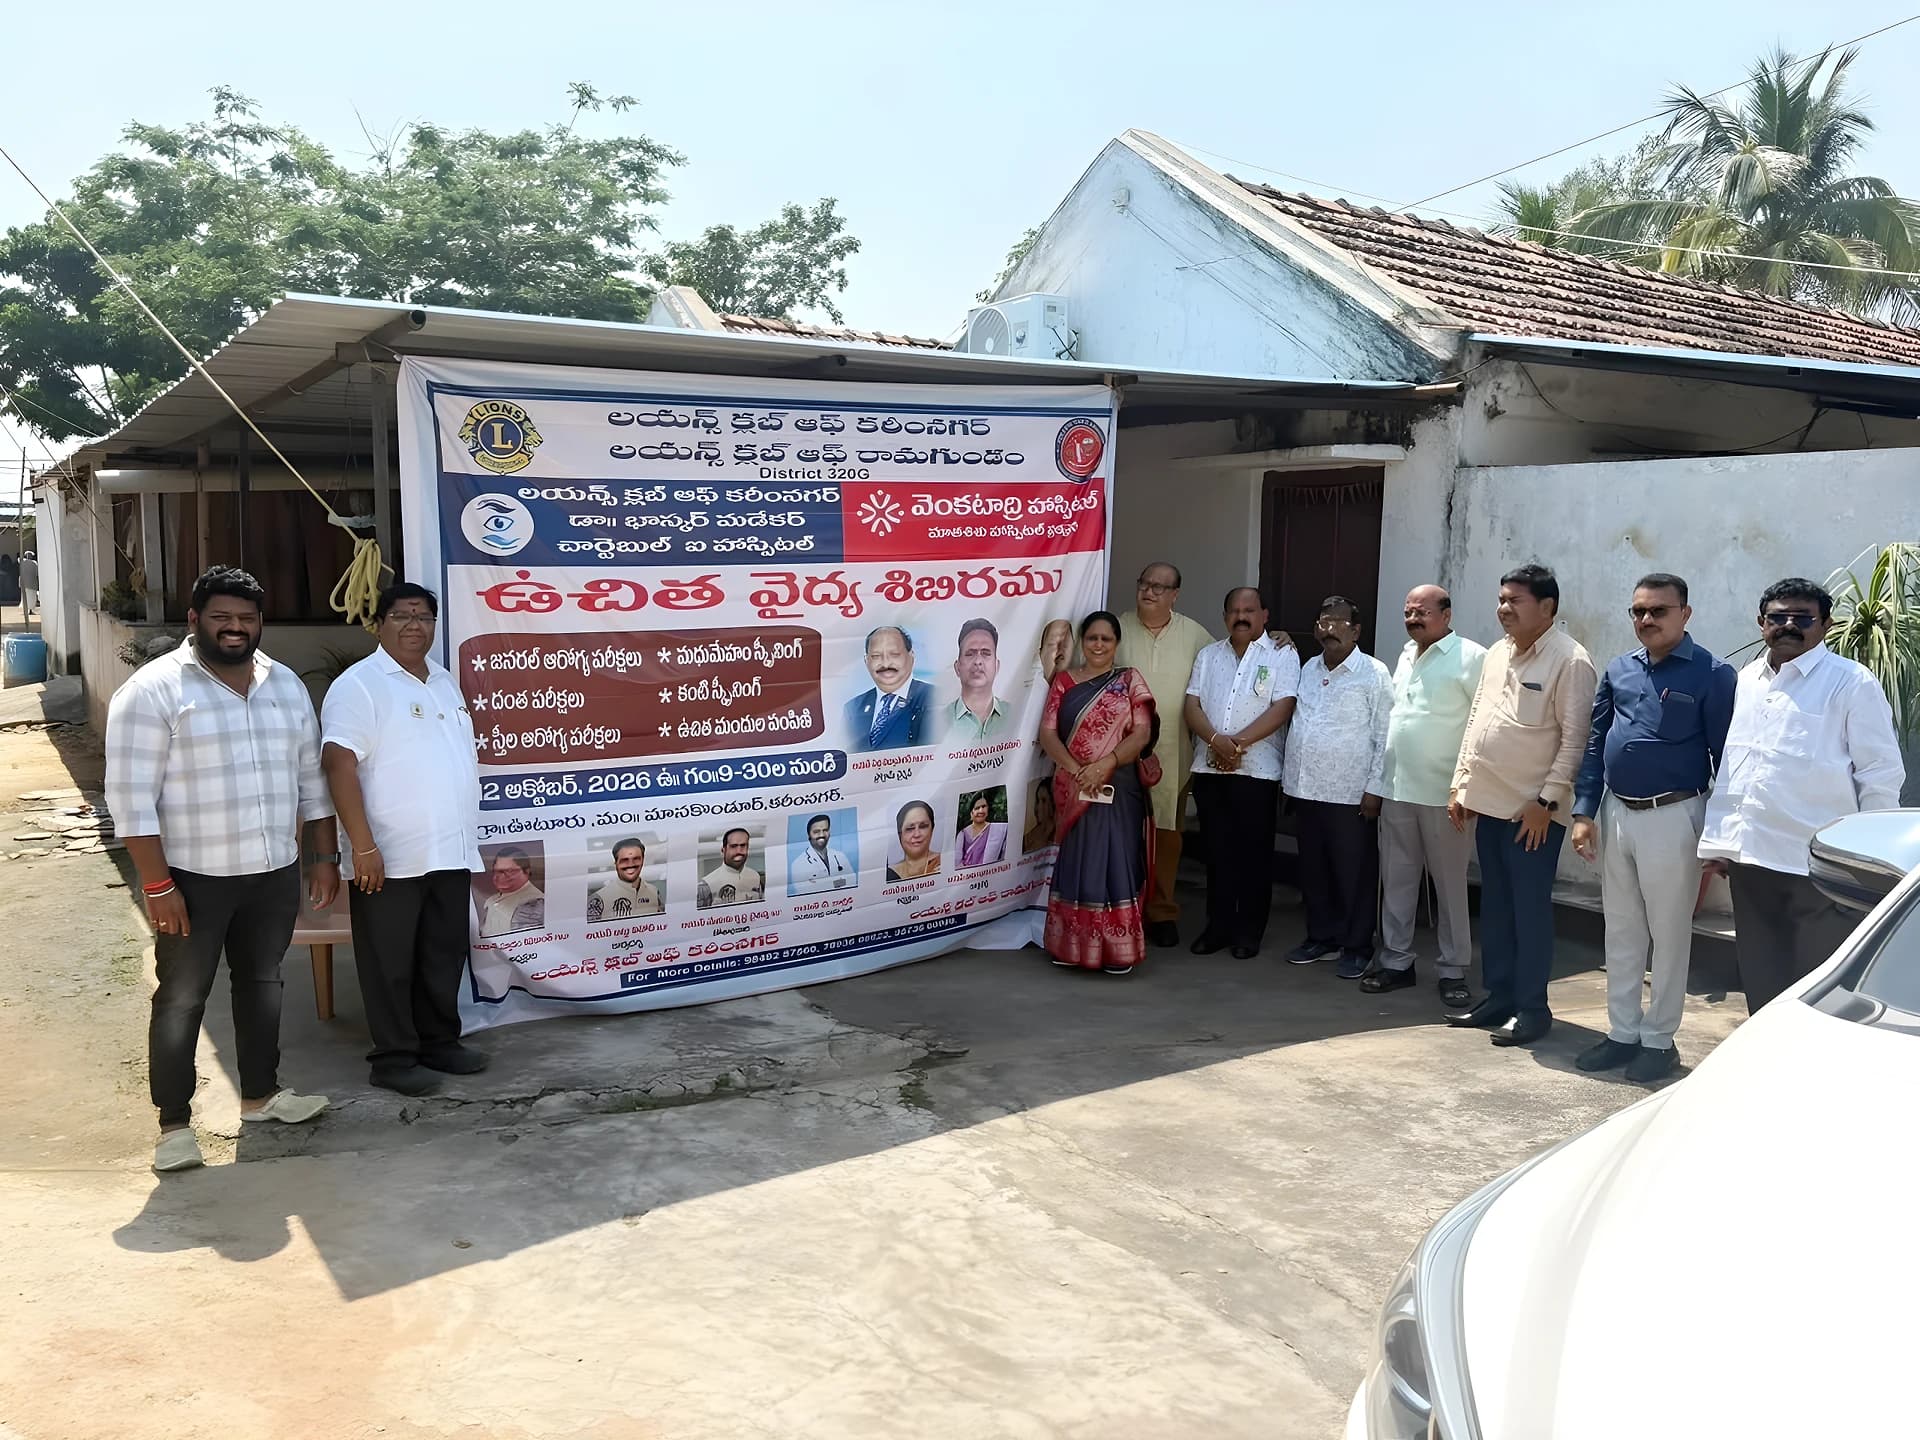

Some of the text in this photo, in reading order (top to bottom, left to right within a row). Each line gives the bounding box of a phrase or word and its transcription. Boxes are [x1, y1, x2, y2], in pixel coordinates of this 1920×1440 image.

[474, 402, 523, 420] LIONS
[607, 409, 991, 436] లయన్స్ క్లబ్ ఆఫ్ కరీంనగర్
[491, 423, 514, 449] L
[609, 441, 1025, 467] లయన్స్ క్లబ్ ఆఫ్ రామగుండం
[759, 467, 870, 480] District 320G
[517, 484, 841, 506] లయన్స్ క్లబ్ ఆఫ్ కరీంనగర్
[911, 490, 1100, 521] వెంకటాద్రి హాస్పిటల్
[624, 512, 710, 532] భాస్కర్
[715, 510, 806, 527] మడేకర్
[685, 540, 707, 552] ఐ
[713, 535, 816, 557] హాస్పిటల్
[476, 565, 1062, 618] ఉచిత వైద్య శిబిరము
[490, 645, 643, 677] జనరల్ ఆరోగ్య పరీక్షలు
[676, 640, 752, 668] మధుమేహం
[491, 686, 585, 714] దంత పరీక్షలు
[677, 679, 709, 702] కంటి
[521, 726, 568, 754] ఆరోగ్య
[569, 723, 621, 750] పరీక్షలు
[677, 717, 713, 738] ఉచిత
[588, 772, 652, 793] 2026
[789, 753, 836, 776] నుండి
[627, 973, 651, 983] For
